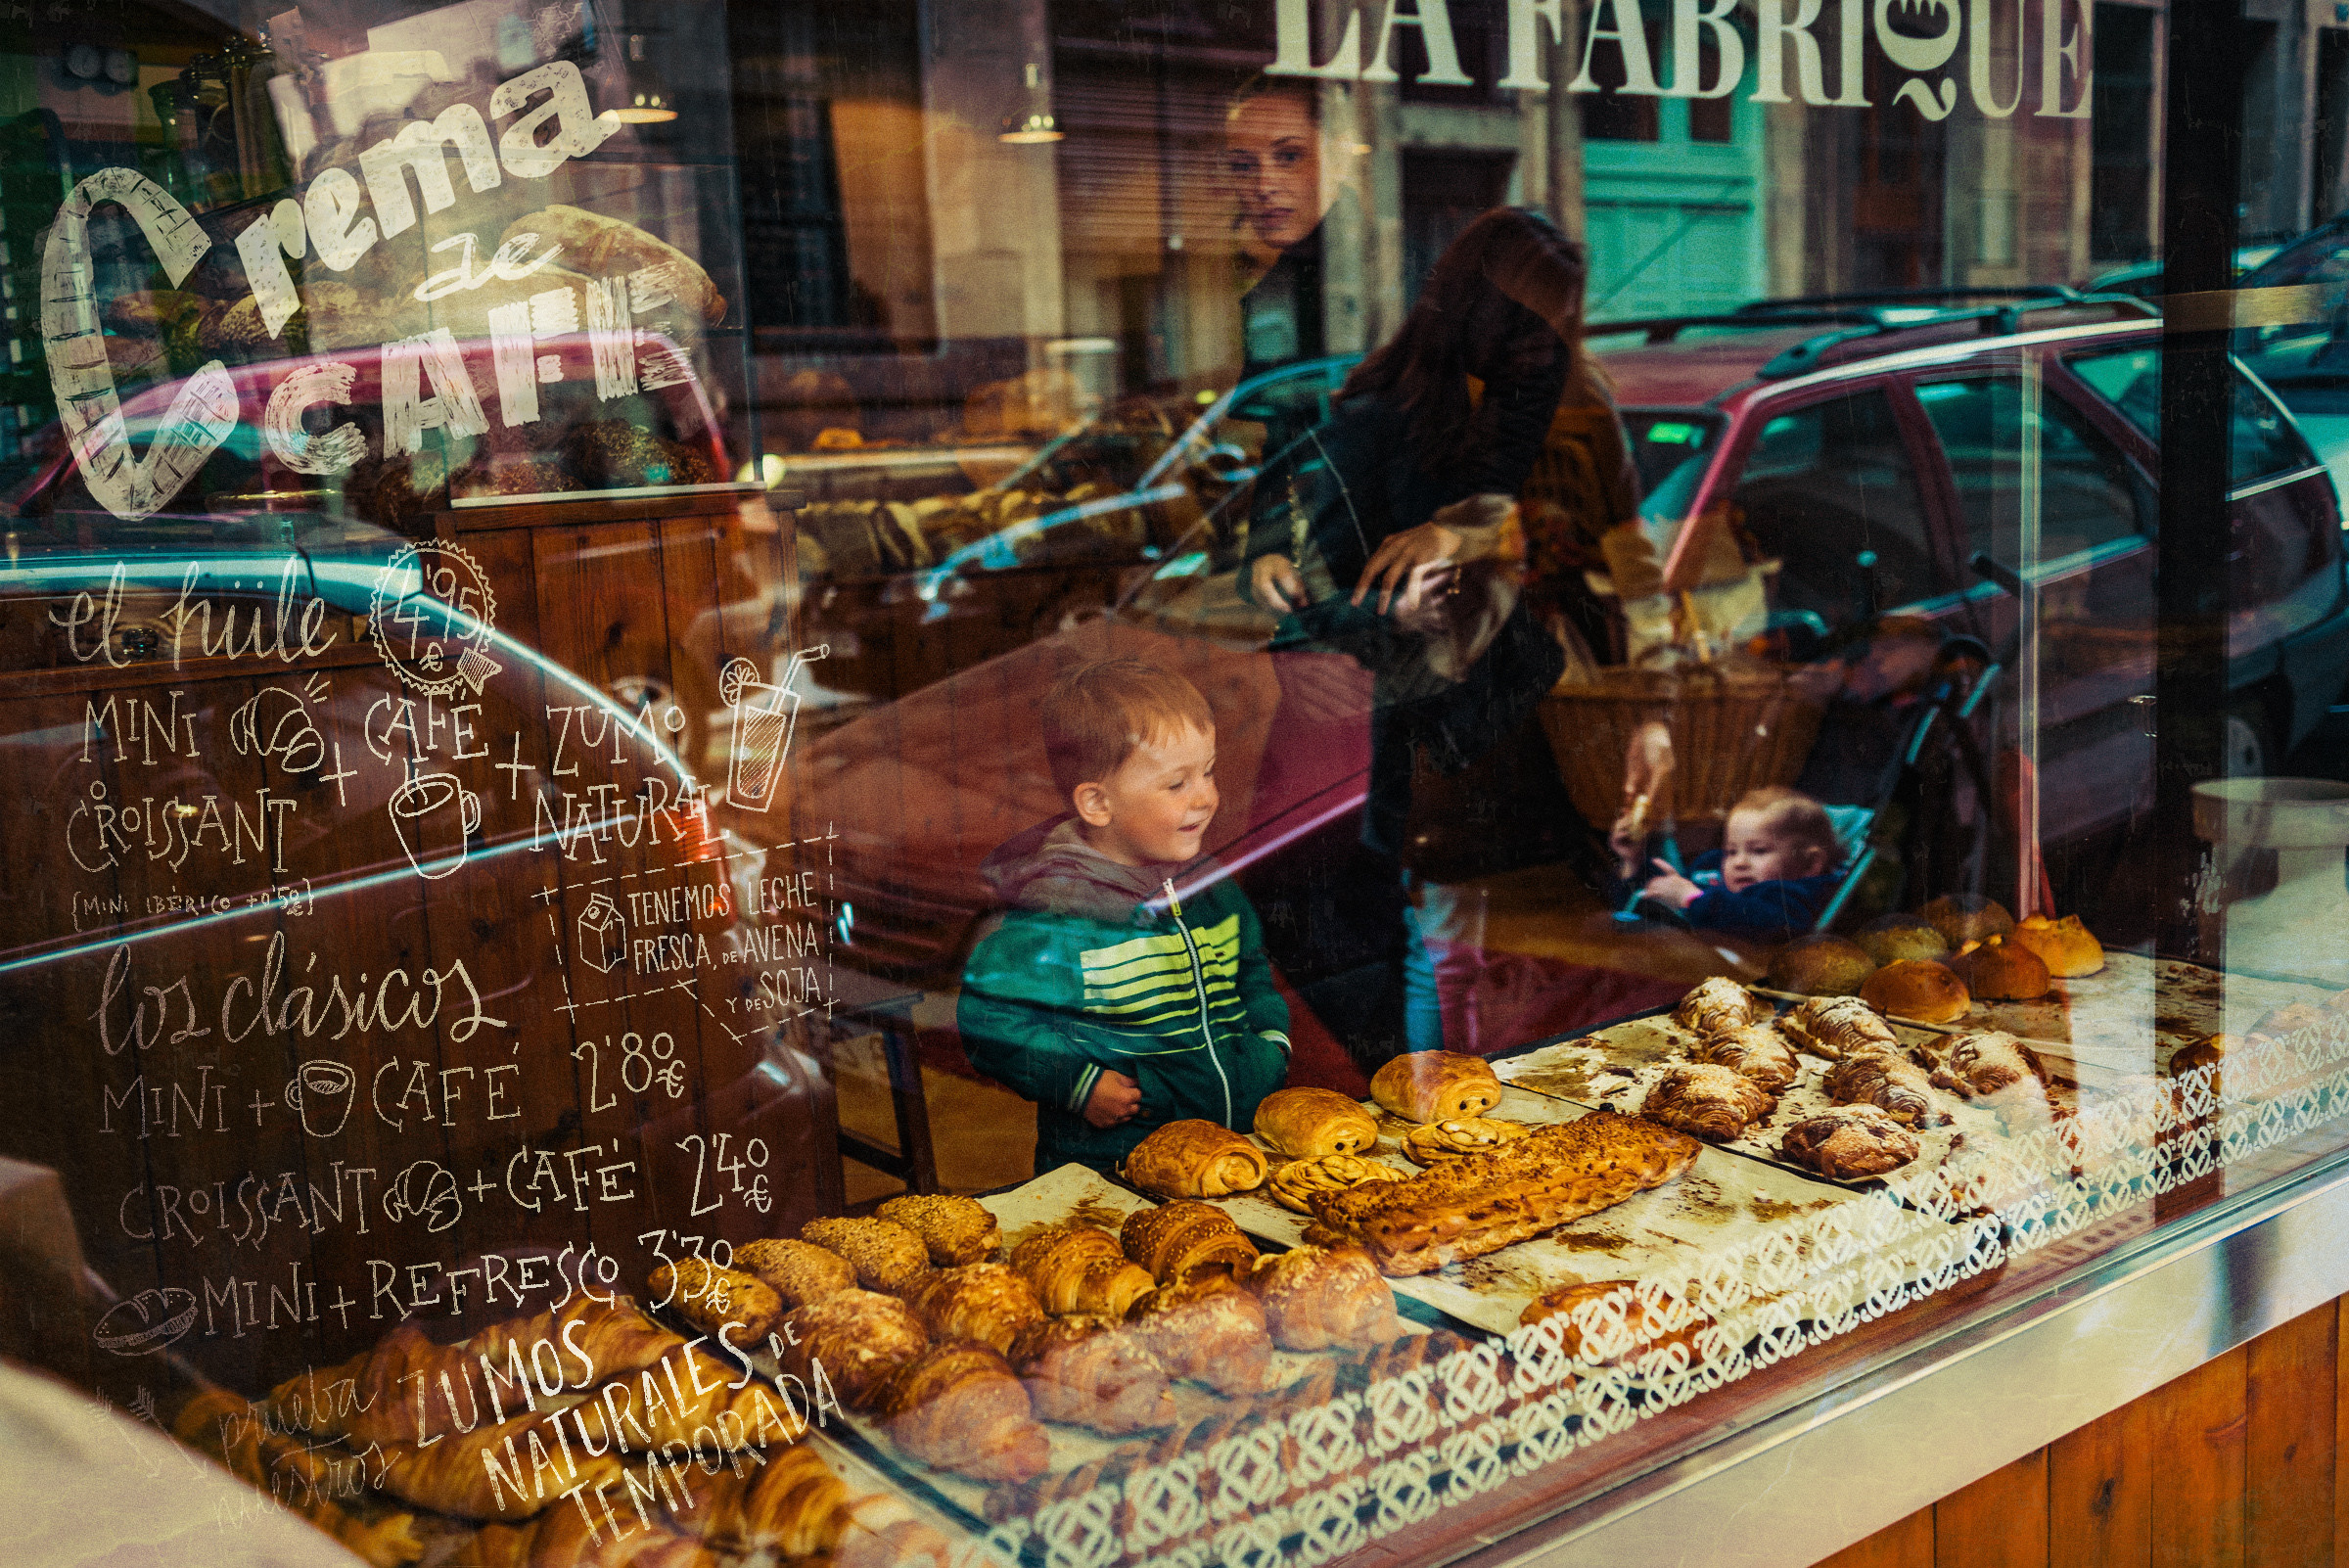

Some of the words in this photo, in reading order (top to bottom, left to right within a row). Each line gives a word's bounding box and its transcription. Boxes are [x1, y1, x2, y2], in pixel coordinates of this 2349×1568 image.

[49, 561, 131, 669] el
[529, 776, 729, 864] NATURAL
[627, 883, 731, 927] TENEMOS
[749, 872, 817, 915] LECHE
[744, 922, 820, 963] AVENA
[760, 967, 821, 1009] SOJA
[99, 1066, 230, 1139] MINI
[366, 1240, 619, 1321] REFRESCO
[396, 1319, 594, 1448] ZUMOS
[482, 1320, 754, 1511] NATURALES
[769, 1321, 802, 1359] DE
[559, 1358, 845, 1547] TEMPORADA
